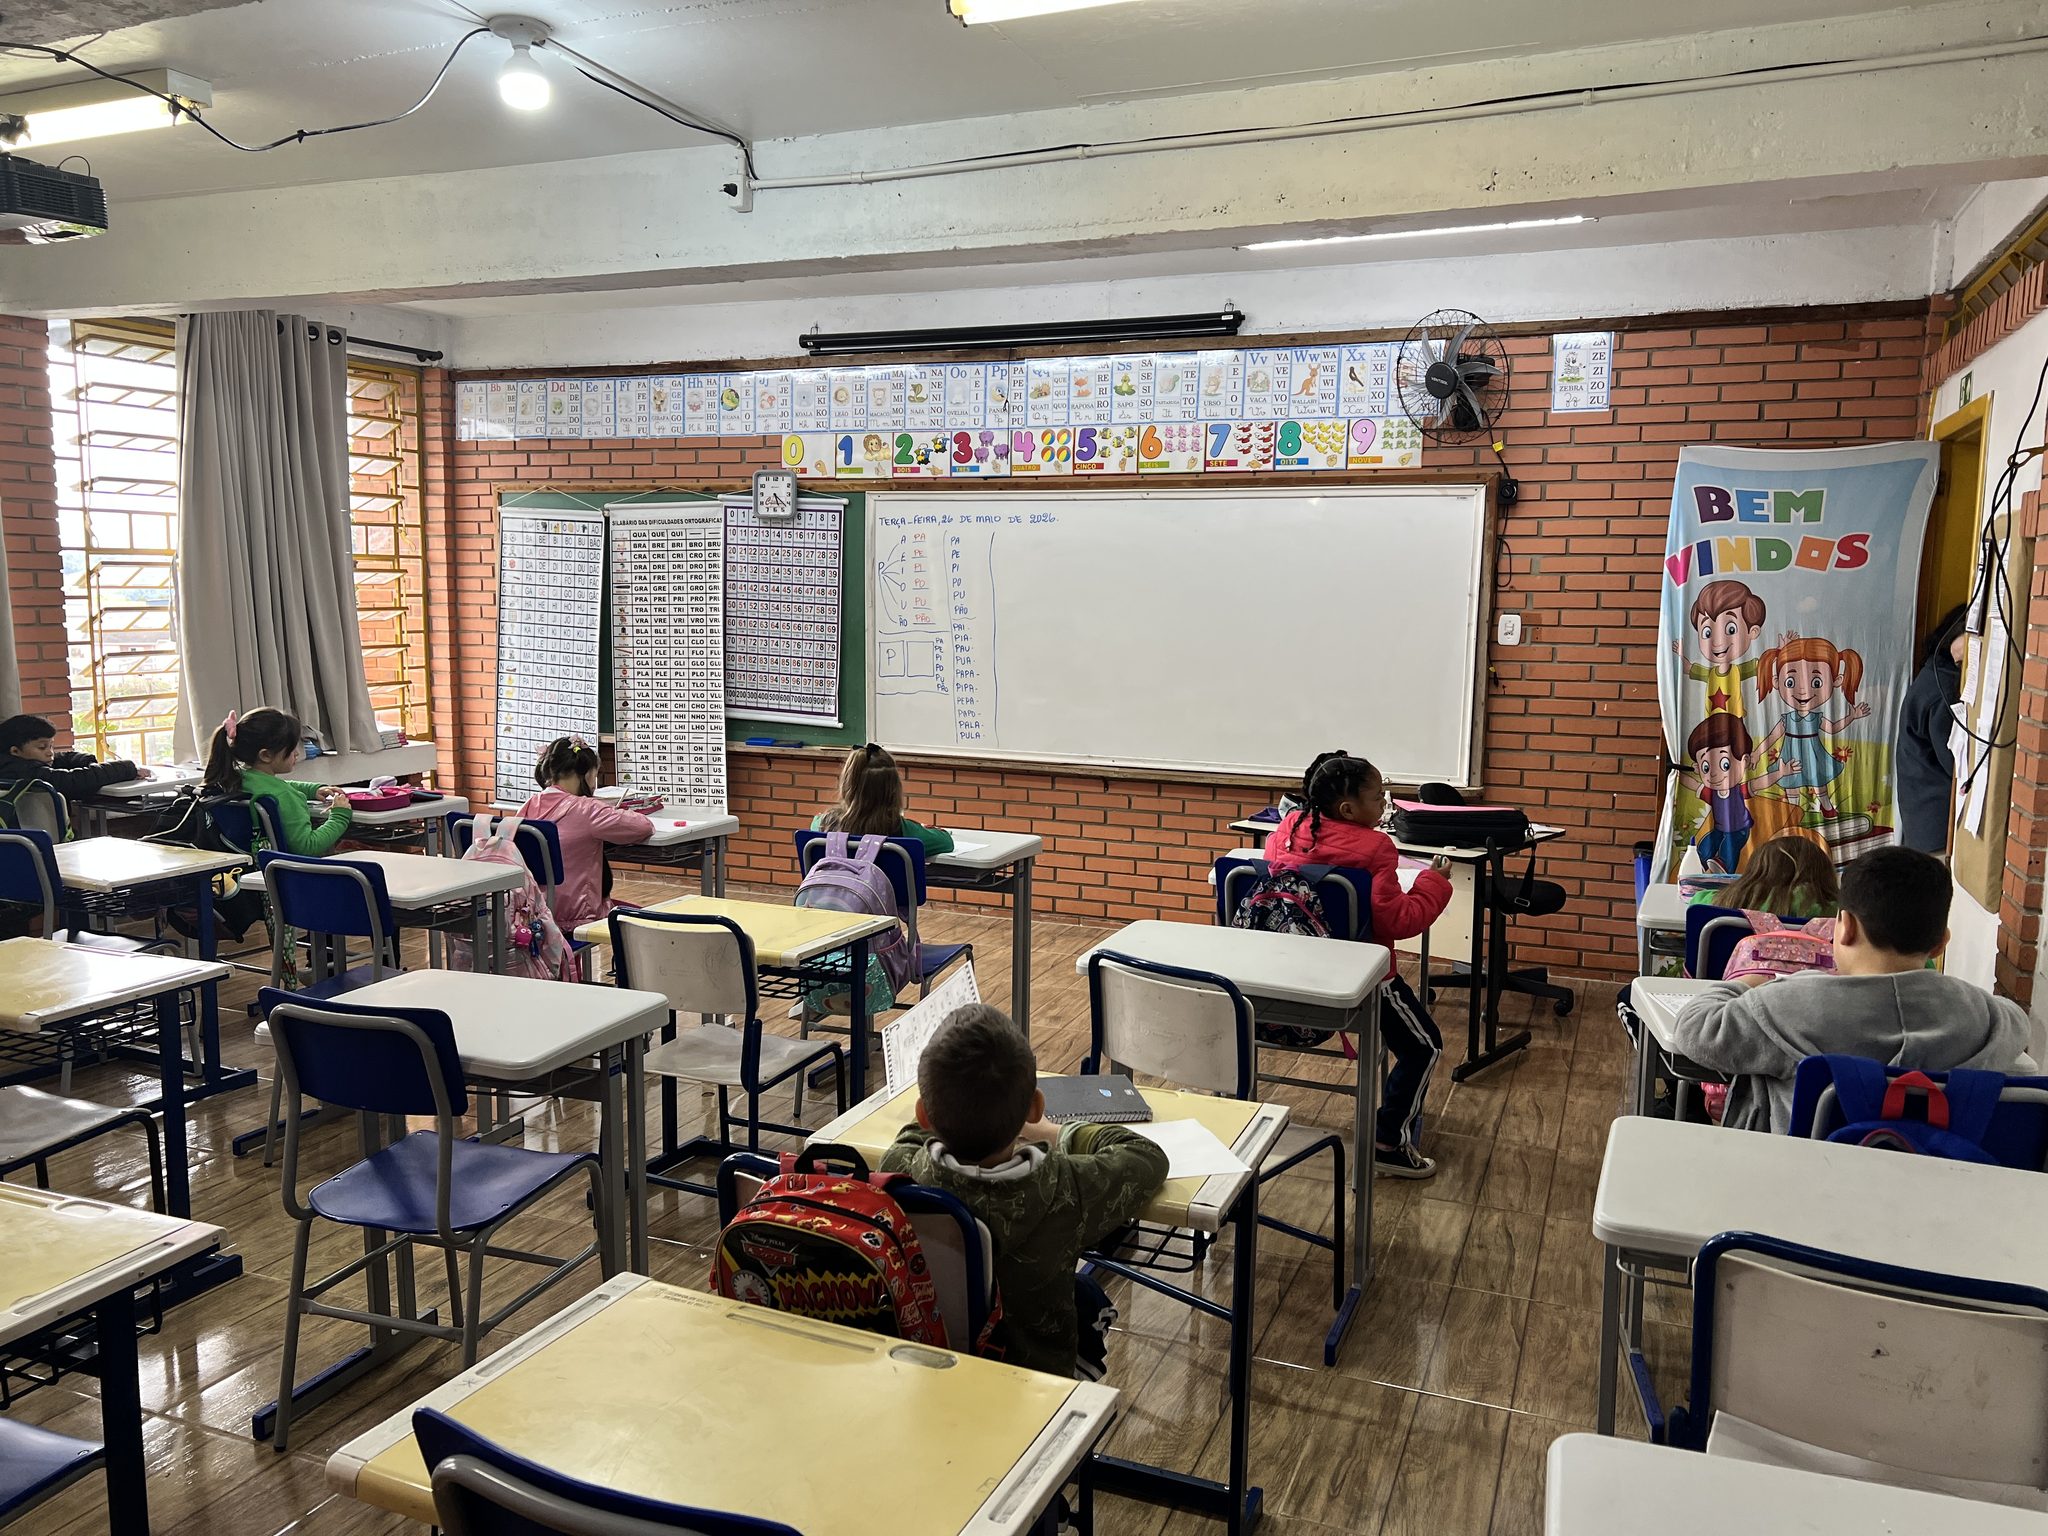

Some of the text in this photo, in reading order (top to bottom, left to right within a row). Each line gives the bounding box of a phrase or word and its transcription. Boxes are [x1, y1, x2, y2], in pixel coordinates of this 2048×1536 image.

[1249, 353, 1268, 365] Vv
[1294, 350, 1320, 363] Ww
[1346, 349, 1366, 361] Xx
[1373, 350, 1387, 358] XA
[1592, 352, 1606, 360] ZE
[950, 366, 967, 379] Oo
[992, 365, 1007, 380] Pp
[1593, 367, 1604, 375] ZI
[551, 382, 565, 393] Dd
[586, 382, 599, 393] Ee
[620, 381, 631, 392] Ff
[687, 377, 703, 388] Hh
[1590, 381, 1605, 389] ZO
[1590, 396, 1604, 404] ZU
[1140, 424, 1163, 460] 6
[1208, 423, 1232, 458] 7
[1277, 420, 1302, 456] 8
[1351, 418, 1376, 455] 9
[782, 434, 804, 466] 0
[838, 435, 853, 466] 1
[894, 433, 915, 465] 2
[953, 431, 973, 464] 3
[1013, 430, 1035, 462] 4
[1075, 428, 1097, 462] 5
[1352, 456, 1372, 464] NOVE
[1693, 485, 1827, 524] BEM
[960, 515, 972, 524] DE
[976, 515, 1001, 524] MAIO
[1008, 515, 1022, 524] DE
[772, 530, 780, 538] 14
[806, 532, 814, 540] 17
[829, 533, 838, 541] 19
[901, 535, 906, 545] A
[950, 536, 960, 546] PA
[901, 552, 906, 562] E
[951, 549, 960, 559] PE
[1665, 532, 1871, 588] VINDOS
[914, 563, 922, 571] PI
[952, 563, 960, 573] PI
[914, 578, 926, 588] PO
[952, 578, 962, 588] PO
[953, 590, 966, 600] PU
[901, 600, 907, 610] U
[915, 597, 927, 607] PU
[935, 645, 943, 653] PE
[886, 648, 896, 666] P
[936, 653, 942, 661] PI
[936, 663, 944, 672] PO
[936, 674, 945, 683] PU
